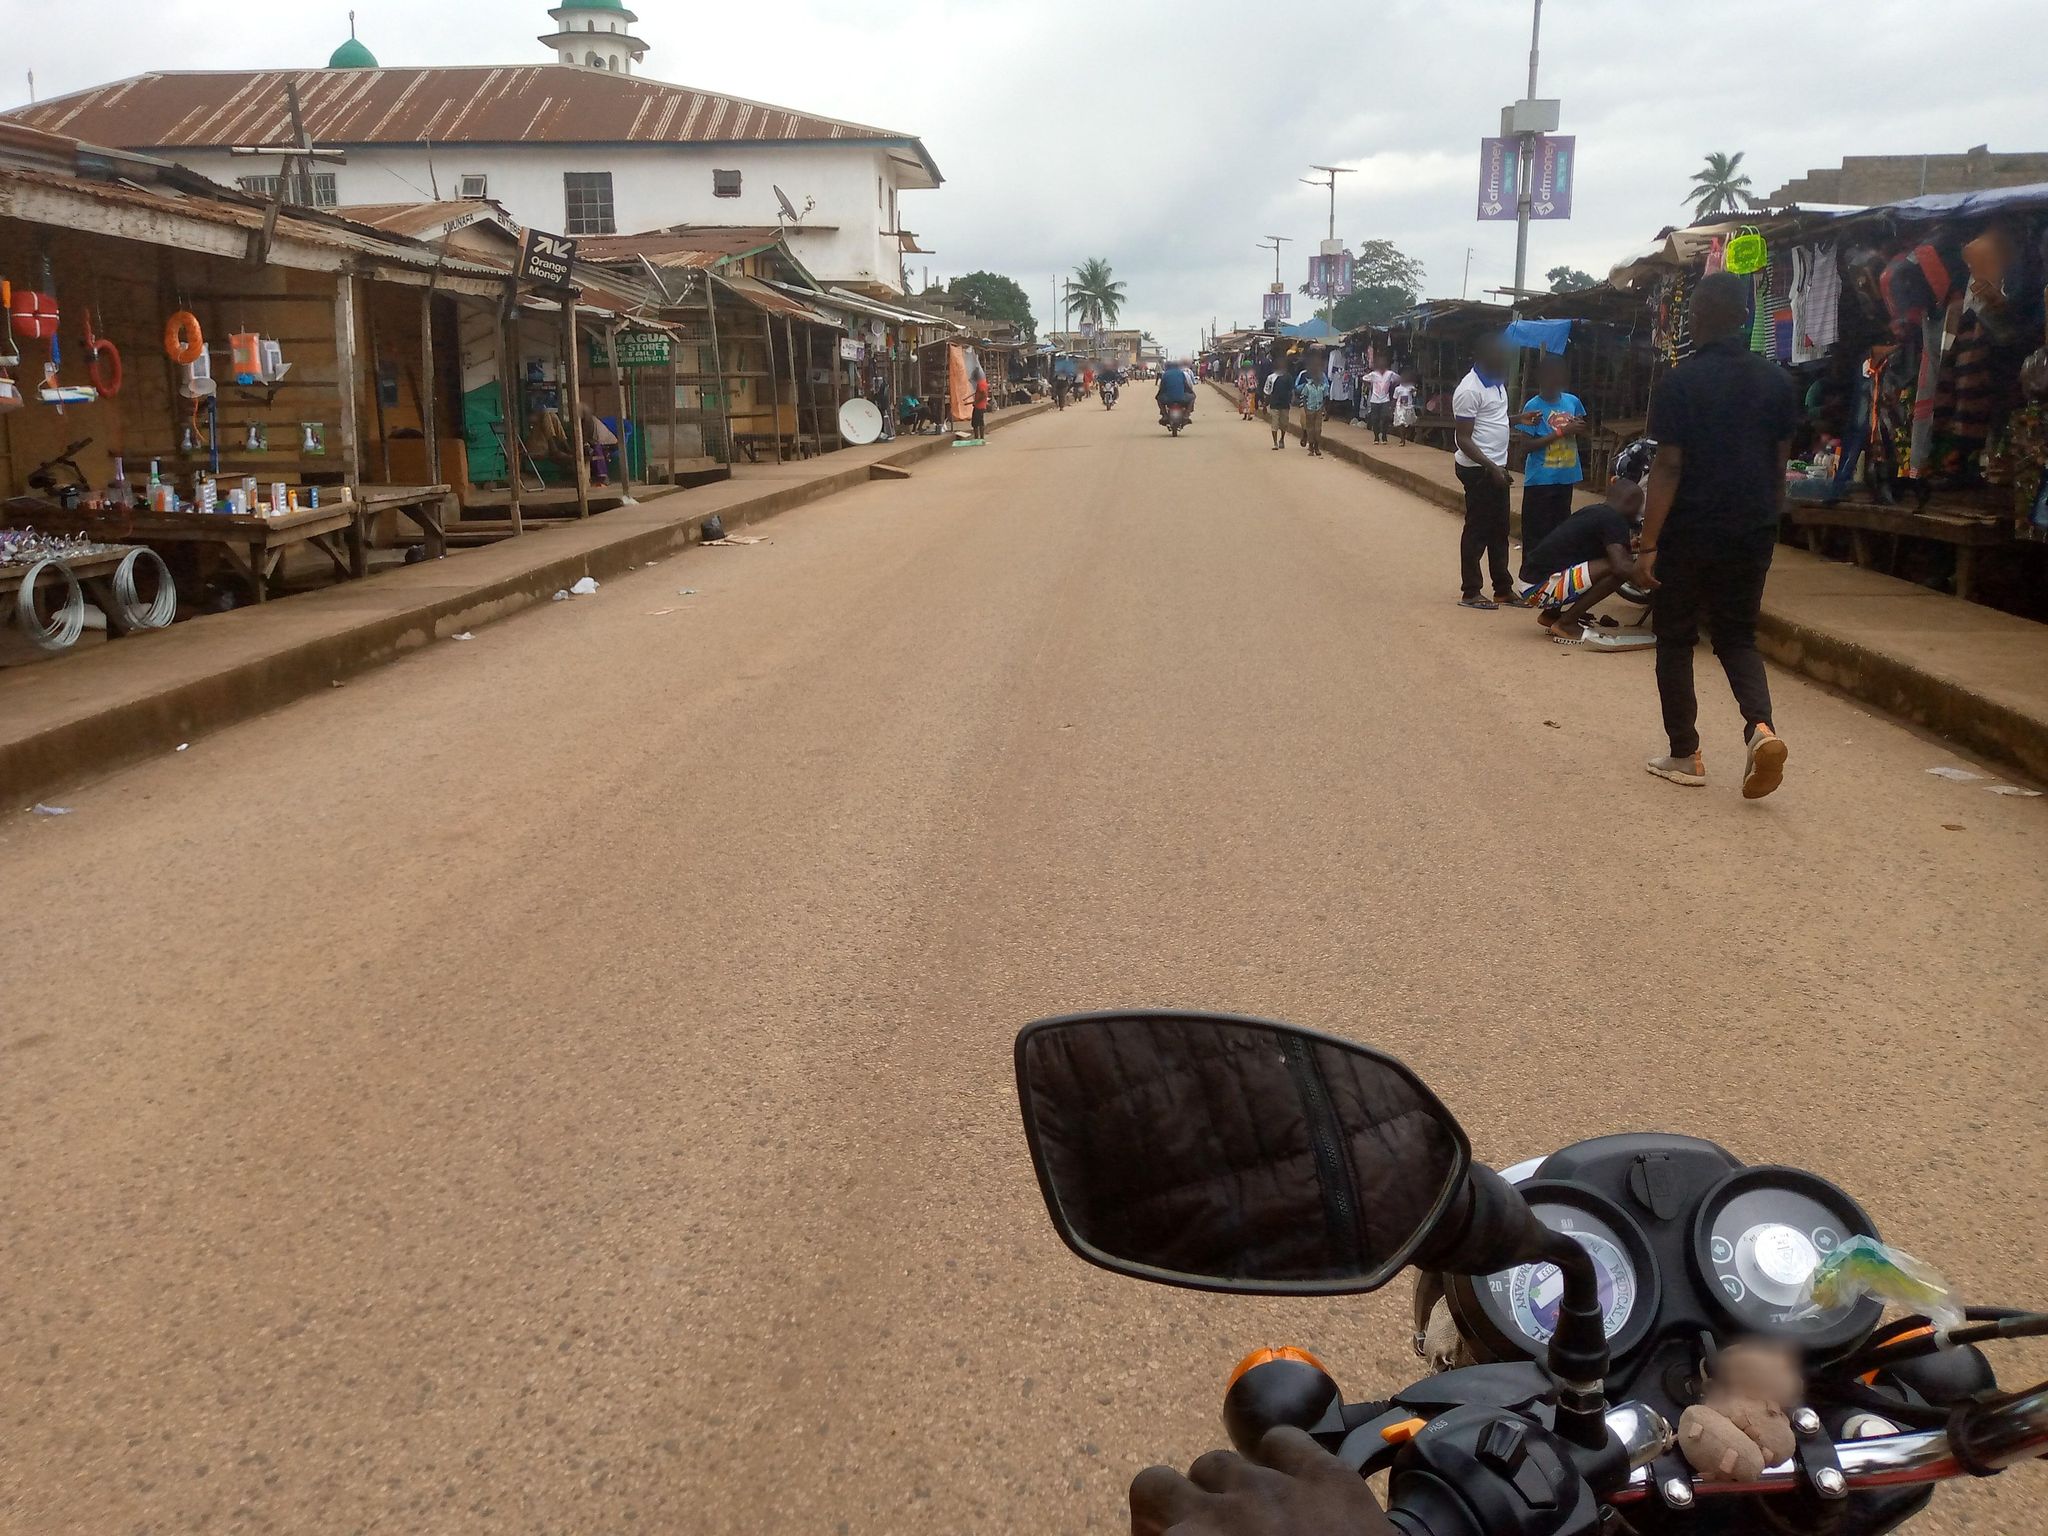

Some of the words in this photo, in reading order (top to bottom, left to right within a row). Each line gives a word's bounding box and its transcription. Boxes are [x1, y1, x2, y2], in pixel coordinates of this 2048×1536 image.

[531, 256, 567, 274] Orange
[528, 266, 562, 283] Money
[1560, 1218, 1574, 1228] 80
[1489, 1280, 1503, 1292] 20
[1427, 1420, 1449, 1433] PASS
